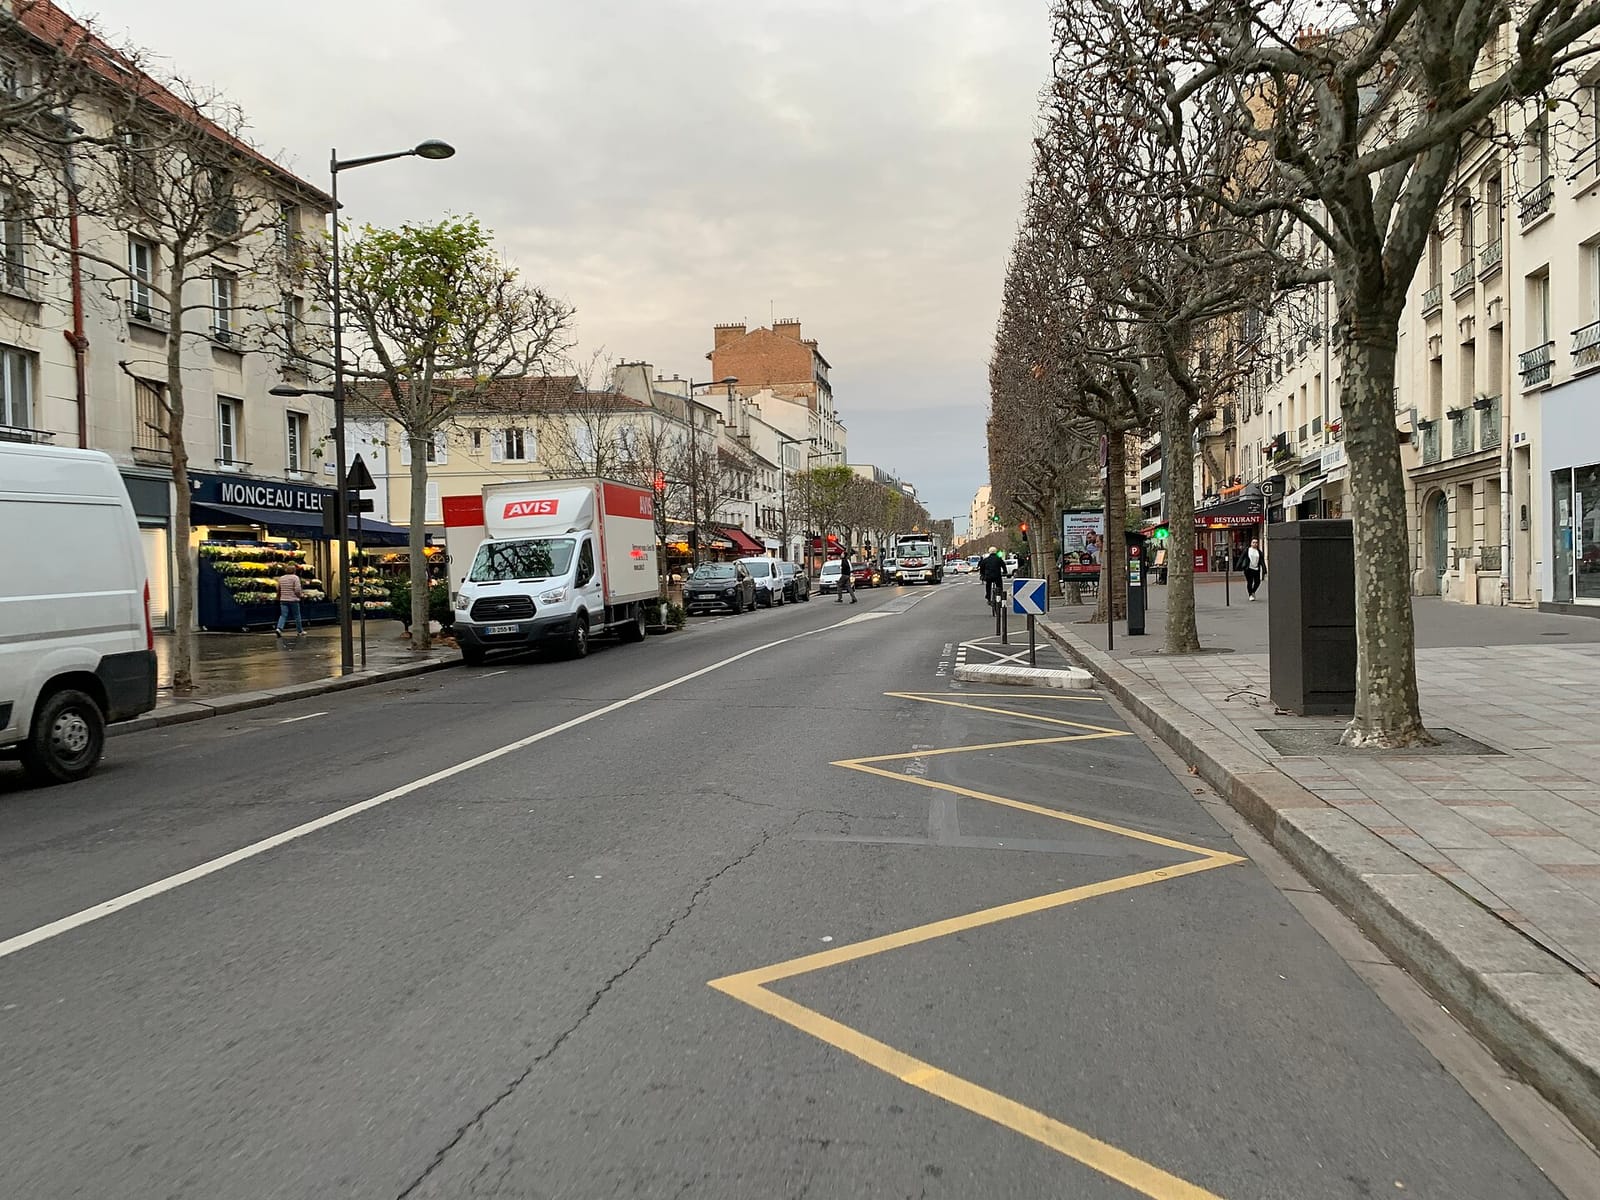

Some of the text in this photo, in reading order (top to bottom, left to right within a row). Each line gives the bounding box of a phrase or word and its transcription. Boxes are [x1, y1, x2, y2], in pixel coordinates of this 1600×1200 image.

[222, 483, 331, 511] MONCEAU FLEU
[640, 496, 653, 515] AVIS
[508, 501, 551, 516] AVIS
[1194, 516, 1206, 524] AFÉ
